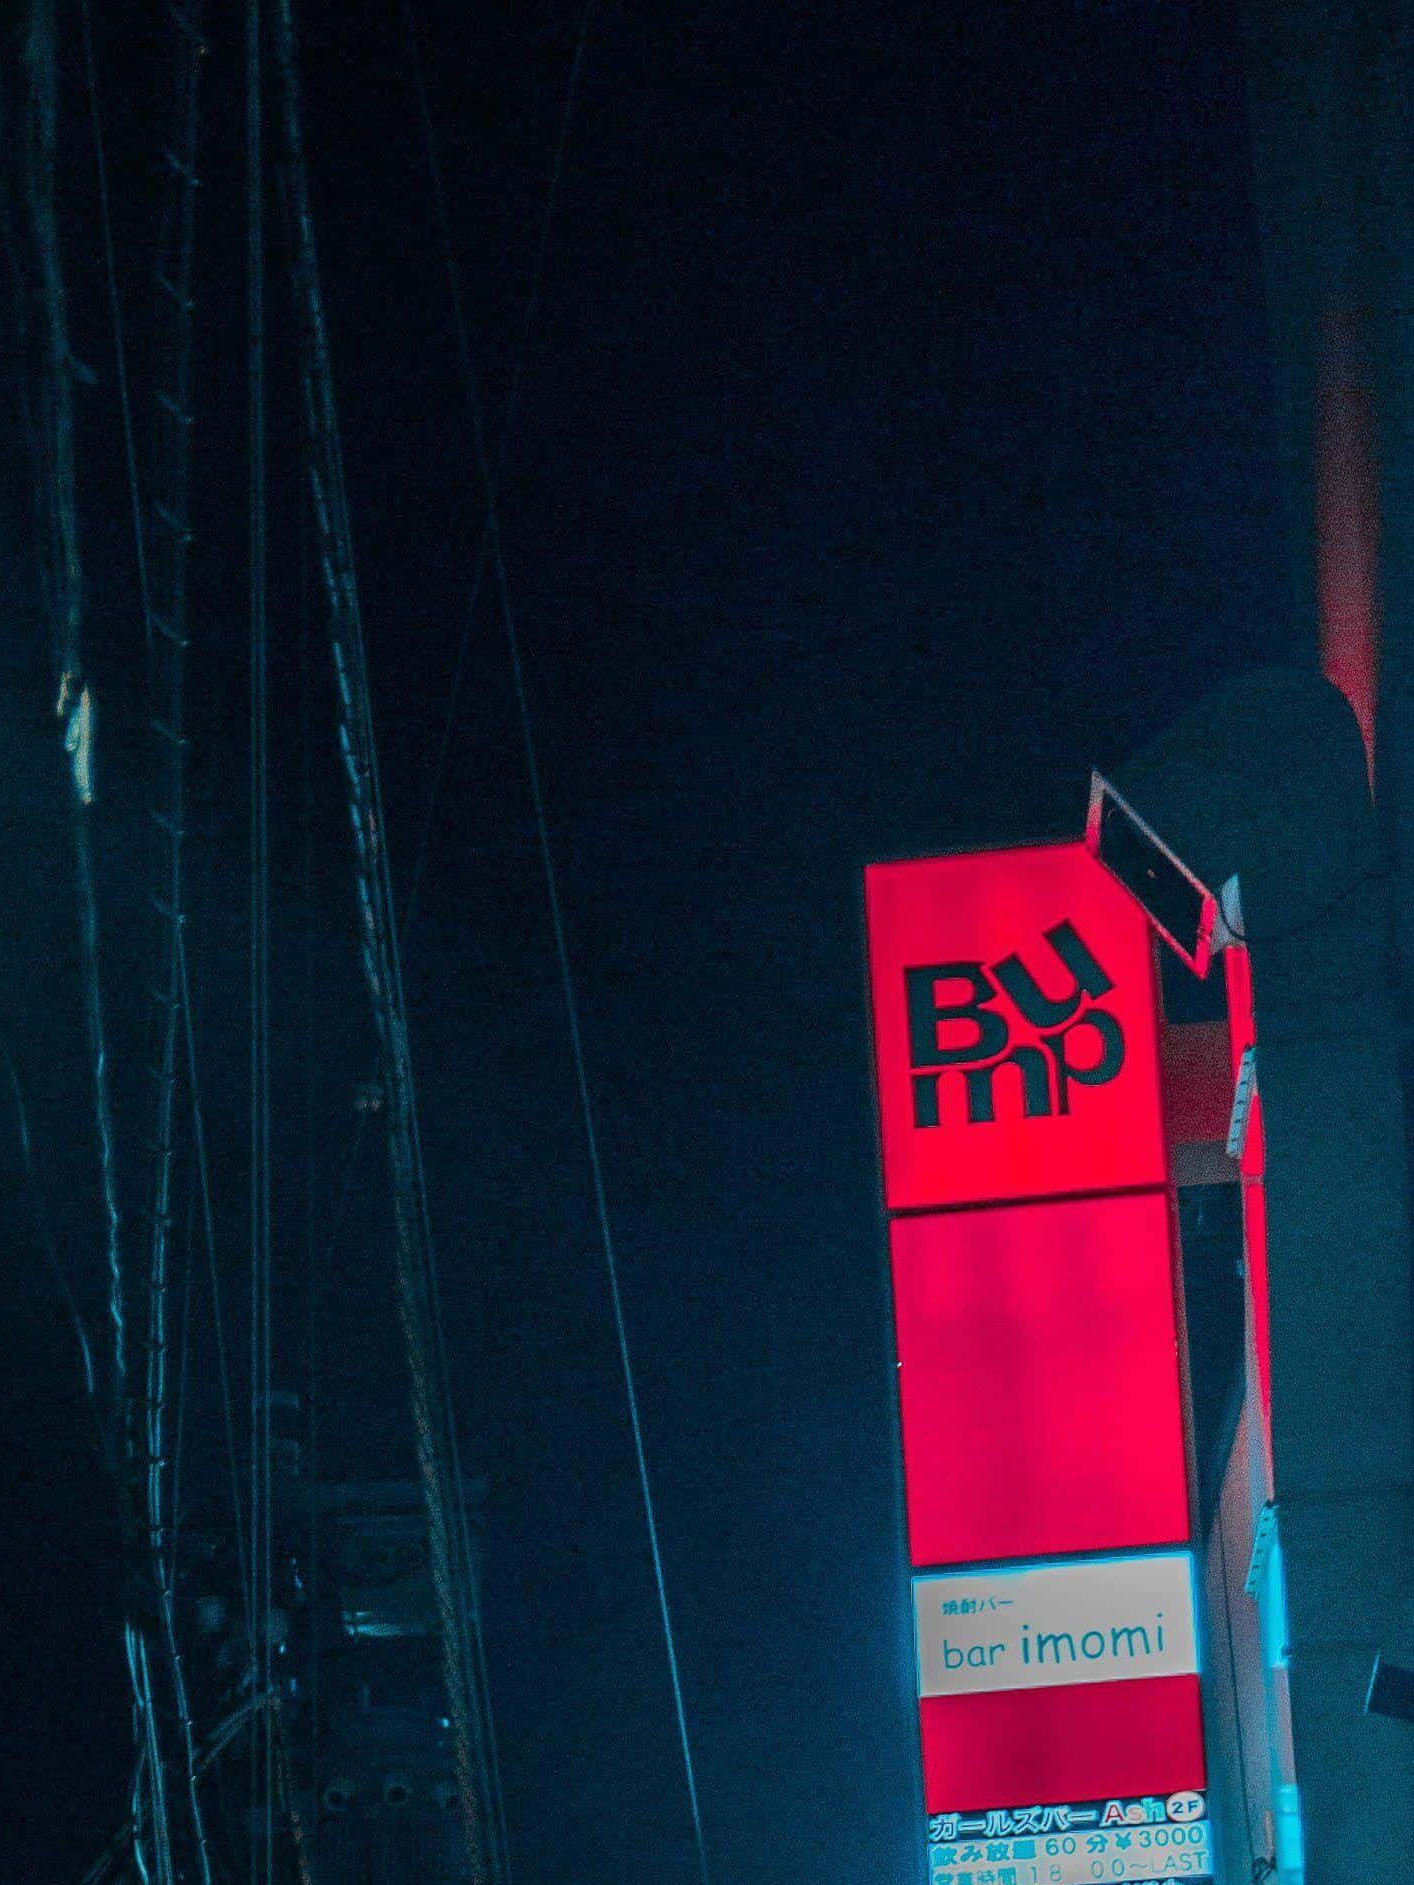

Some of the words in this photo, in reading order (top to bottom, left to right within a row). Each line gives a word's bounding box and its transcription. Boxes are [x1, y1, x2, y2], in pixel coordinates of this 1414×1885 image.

[943, 1639, 1005, 1669] bar
[1022, 1612, 1164, 1664] imomi
[929, 1805, 1098, 1841] ガールズバー
[1099, 1798, 1166, 1827] Ash
[1171, 1800, 1199, 1815] 2F
